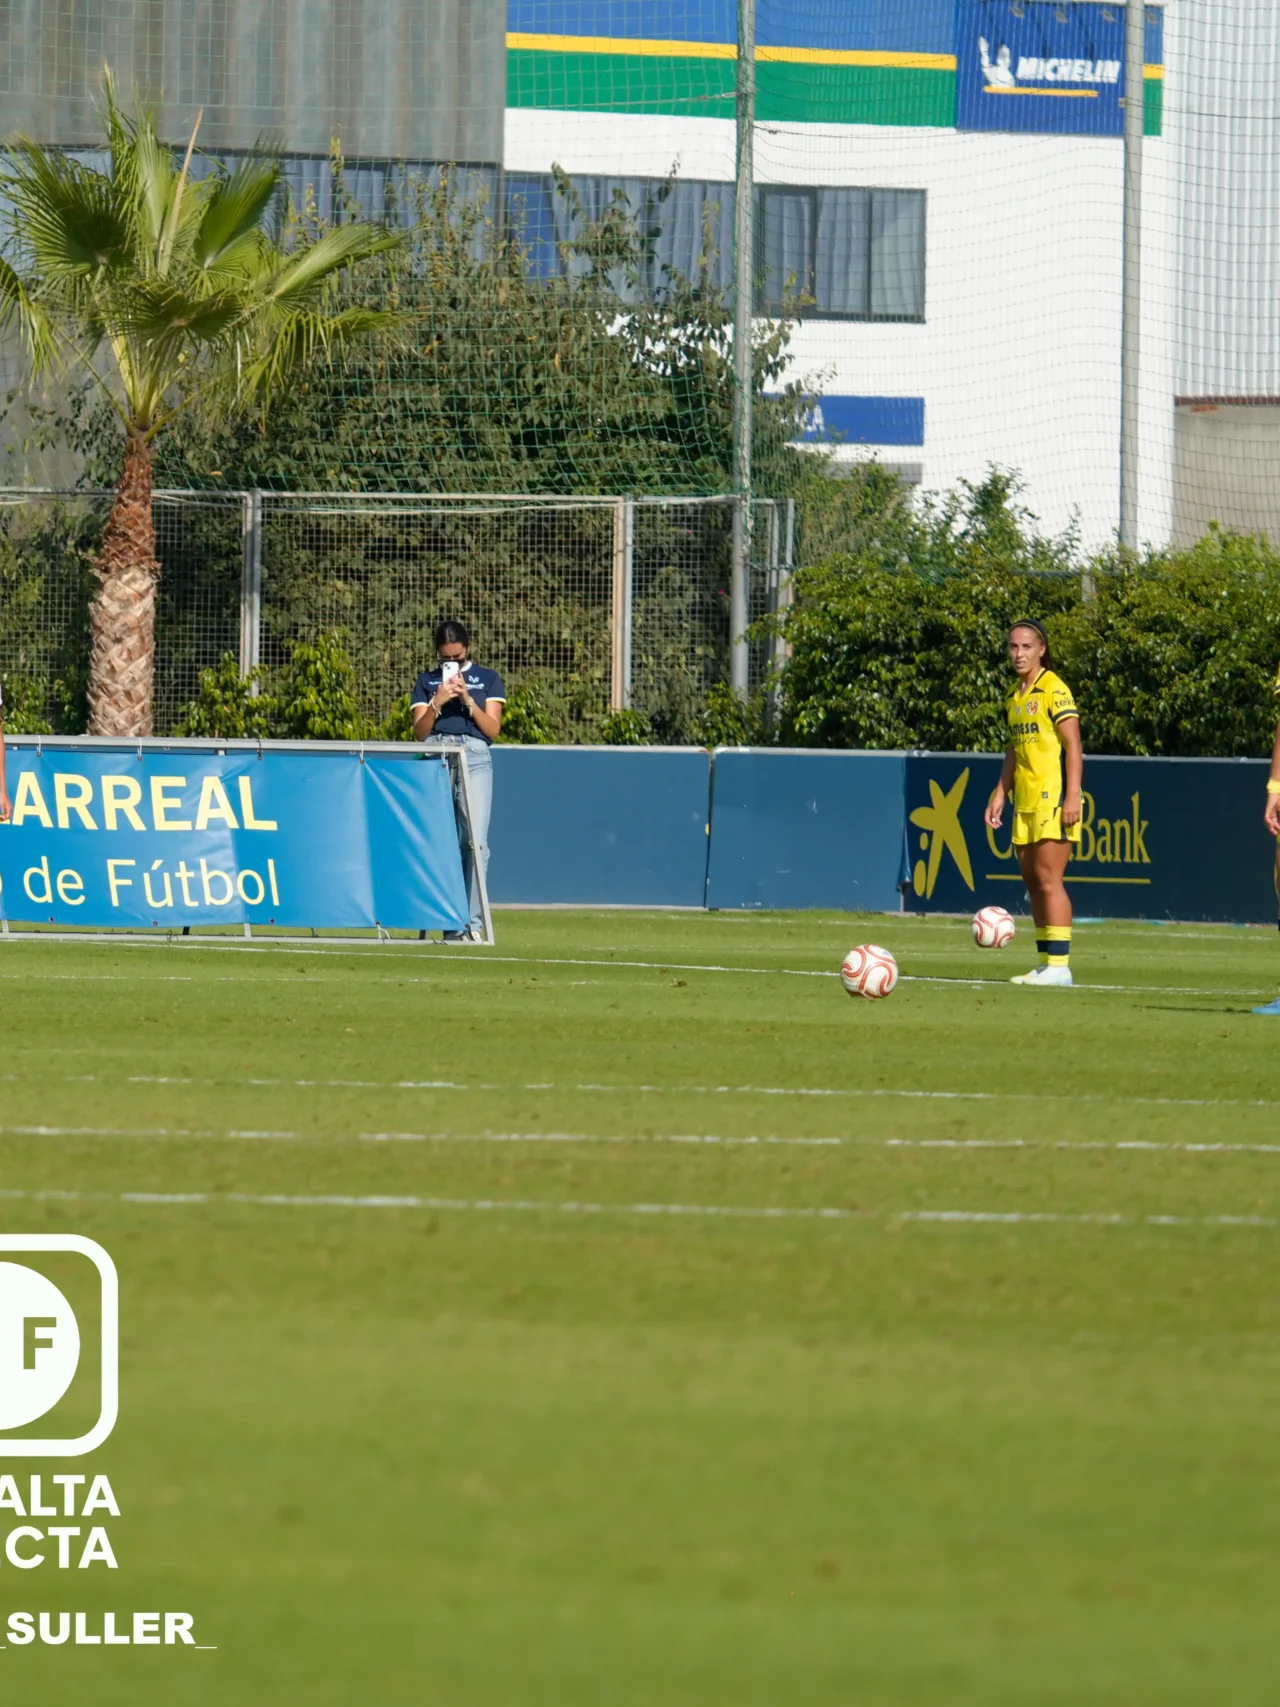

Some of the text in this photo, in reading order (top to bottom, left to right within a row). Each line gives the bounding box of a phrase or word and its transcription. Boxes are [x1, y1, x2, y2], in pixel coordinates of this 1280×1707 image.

[1017, 57, 1120, 84] MICHELIN
[986, 787, 1151, 863] CBank
[23, 855, 86, 905] de
[107, 858, 280, 907] Fútbol
